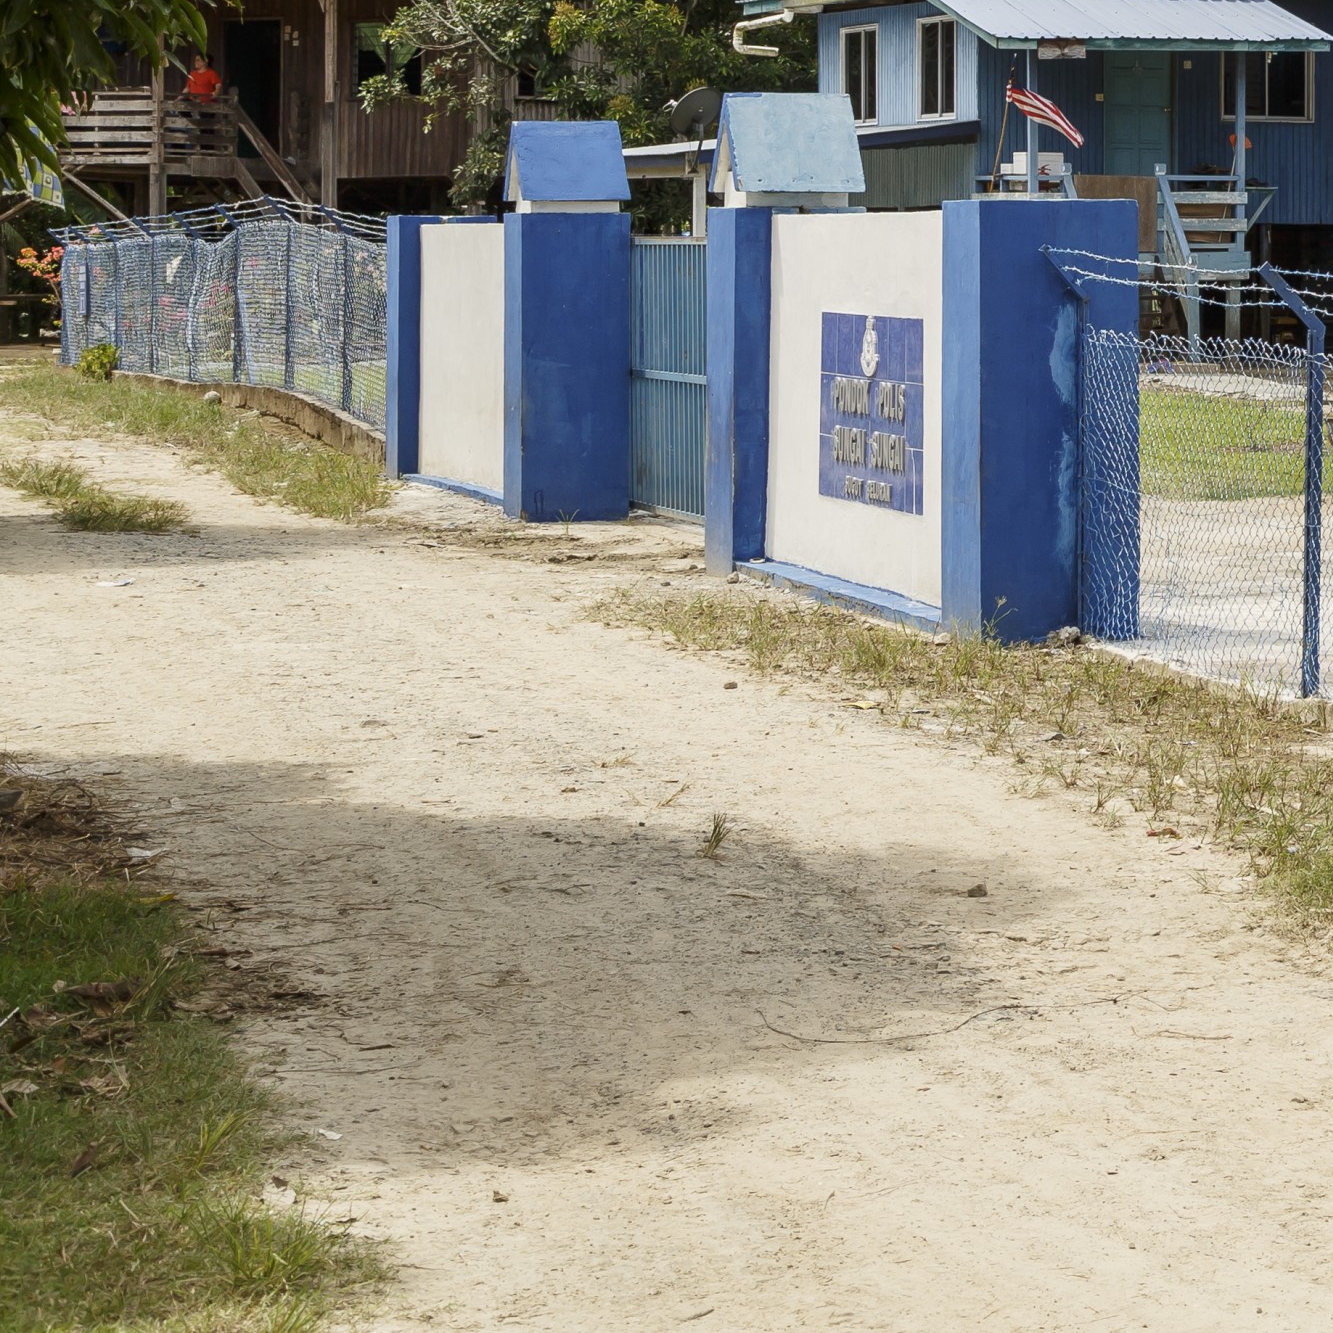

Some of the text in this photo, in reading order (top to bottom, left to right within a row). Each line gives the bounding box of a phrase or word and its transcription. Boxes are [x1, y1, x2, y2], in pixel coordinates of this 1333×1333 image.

[834, 376, 905, 421] PONDOK POLIS
[833, 425, 905, 472] SUNGAI SUNGAI
